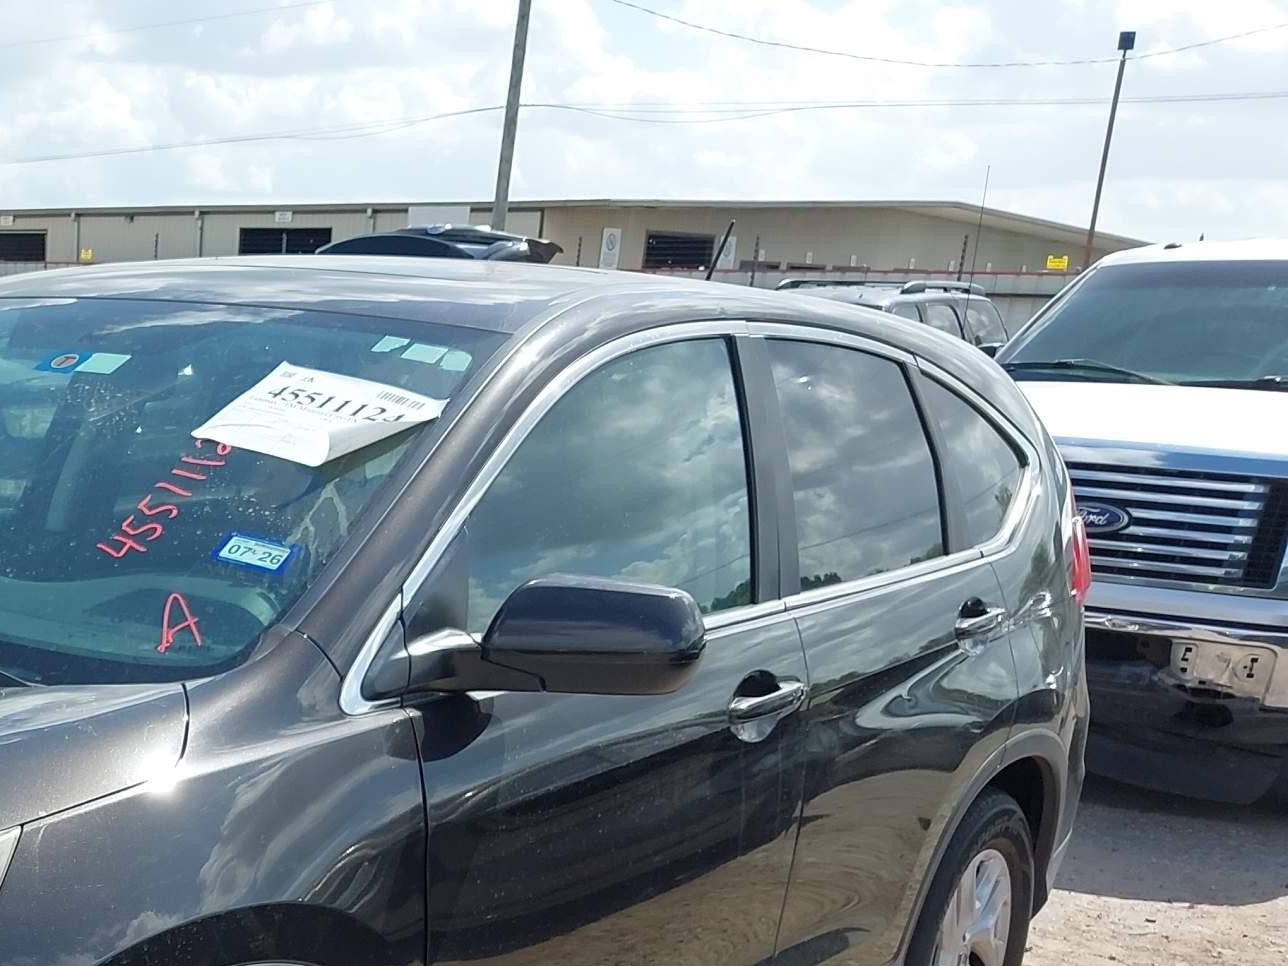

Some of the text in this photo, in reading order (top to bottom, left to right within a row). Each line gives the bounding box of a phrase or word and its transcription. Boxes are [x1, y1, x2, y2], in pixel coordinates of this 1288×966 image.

[228, 544, 283, 565] 07 26
[157, 593, 199, 652] A
